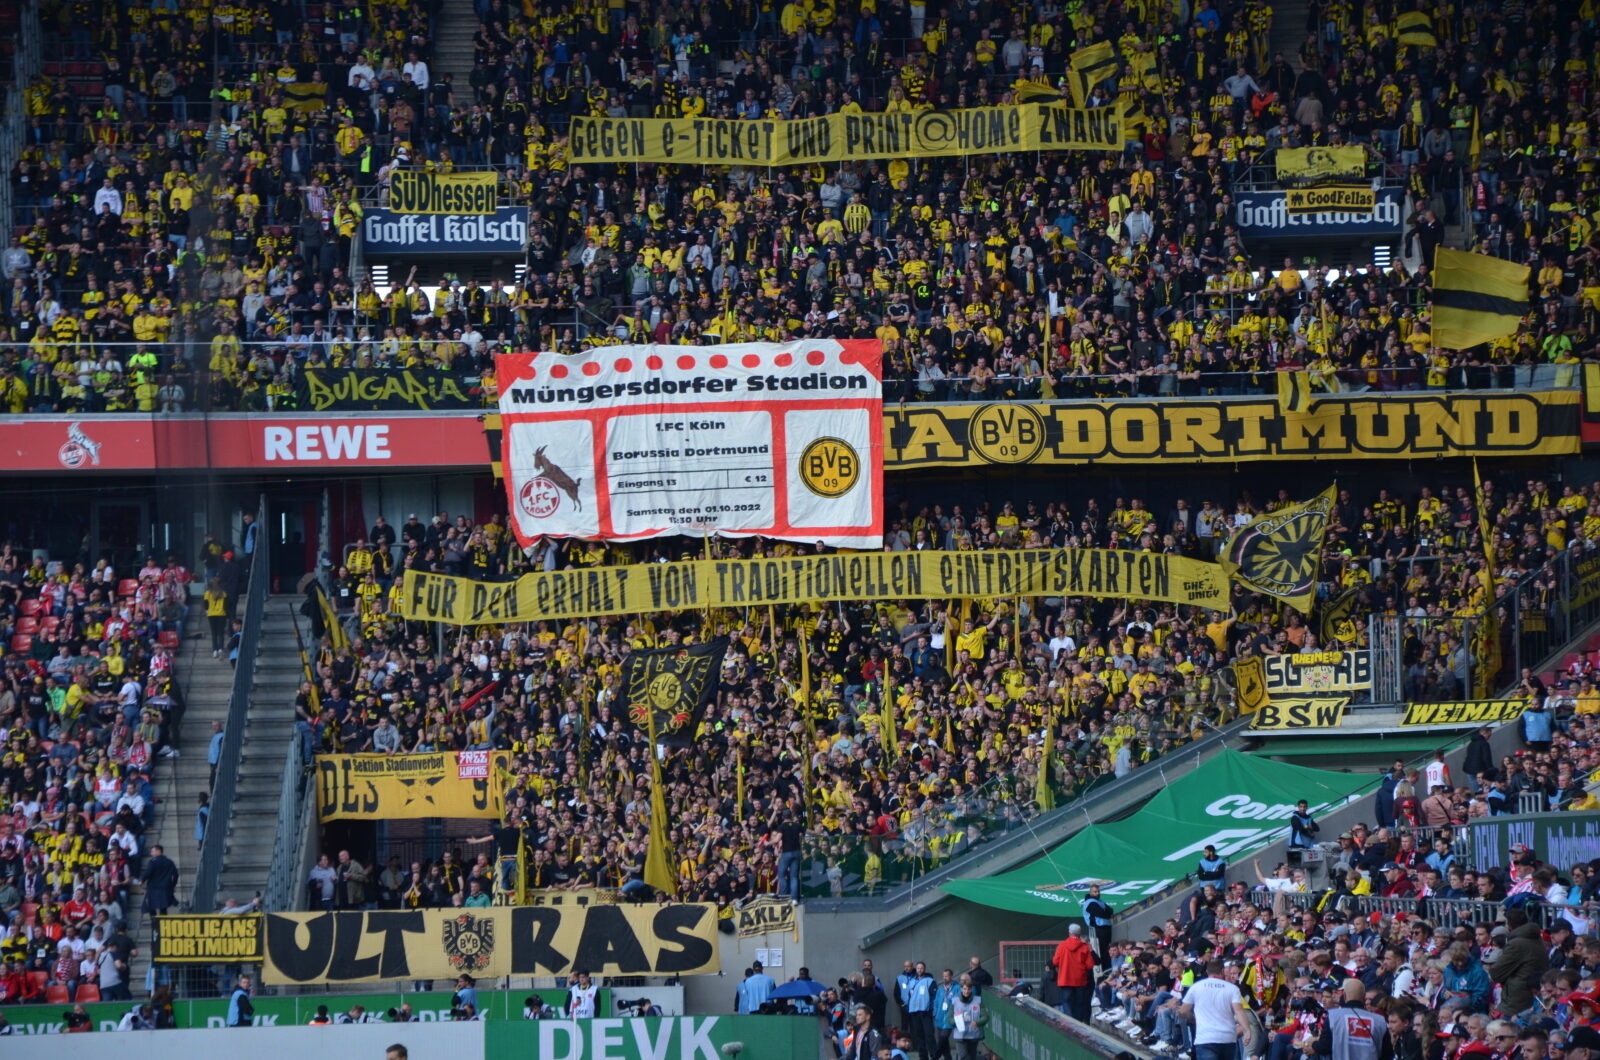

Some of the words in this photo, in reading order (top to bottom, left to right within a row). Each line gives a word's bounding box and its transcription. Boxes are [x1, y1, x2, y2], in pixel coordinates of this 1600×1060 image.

[787, 118, 831, 158] UND
[1038, 105, 1118, 145] ZWANG
[1306, 190, 1373, 205] GoodFellas
[365, 215, 441, 246] Gaffel
[443, 213, 526, 246] Kölsch
[511, 376, 738, 404] Müngersdorfer
[746, 374, 868, 392] Stadion
[655, 422, 685, 432] 1.FC
[689, 420, 726, 431] Köln
[981, 409, 1036, 446] BVB
[1055, 397, 1540, 455] DORTMUND
[264, 425, 391, 461] REWE
[612, 448, 680, 461] Borussia
[685, 444, 769, 457] Dortmund
[1000, 445, 1019, 457] 09
[810, 446, 851, 478] BVB
[617, 479, 664, 490] Eingang
[666, 479, 677, 487] 13
[755, 475, 767, 483] 12
[824, 478, 839, 488] 09
[626, 507, 676, 517] Samstag
[678, 506, 701, 515] den
[705, 503, 761, 513] 01.10.2022
[696, 515, 718, 524] Uhr
[410, 573, 458, 619] FÜR
[650, 563, 698, 609] VON
[1266, 655, 1302, 688] SG
[1256, 699, 1345, 728] BSW
[1409, 701, 1523, 723] WEIMAR
[352, 758, 385, 773] Sektion
[459, 751, 488, 764] FREE
[159, 918, 257, 938] HOOLIGANS
[159, 937, 257, 956] DORTMUND
[538, 1015, 721, 1060] DEVK
